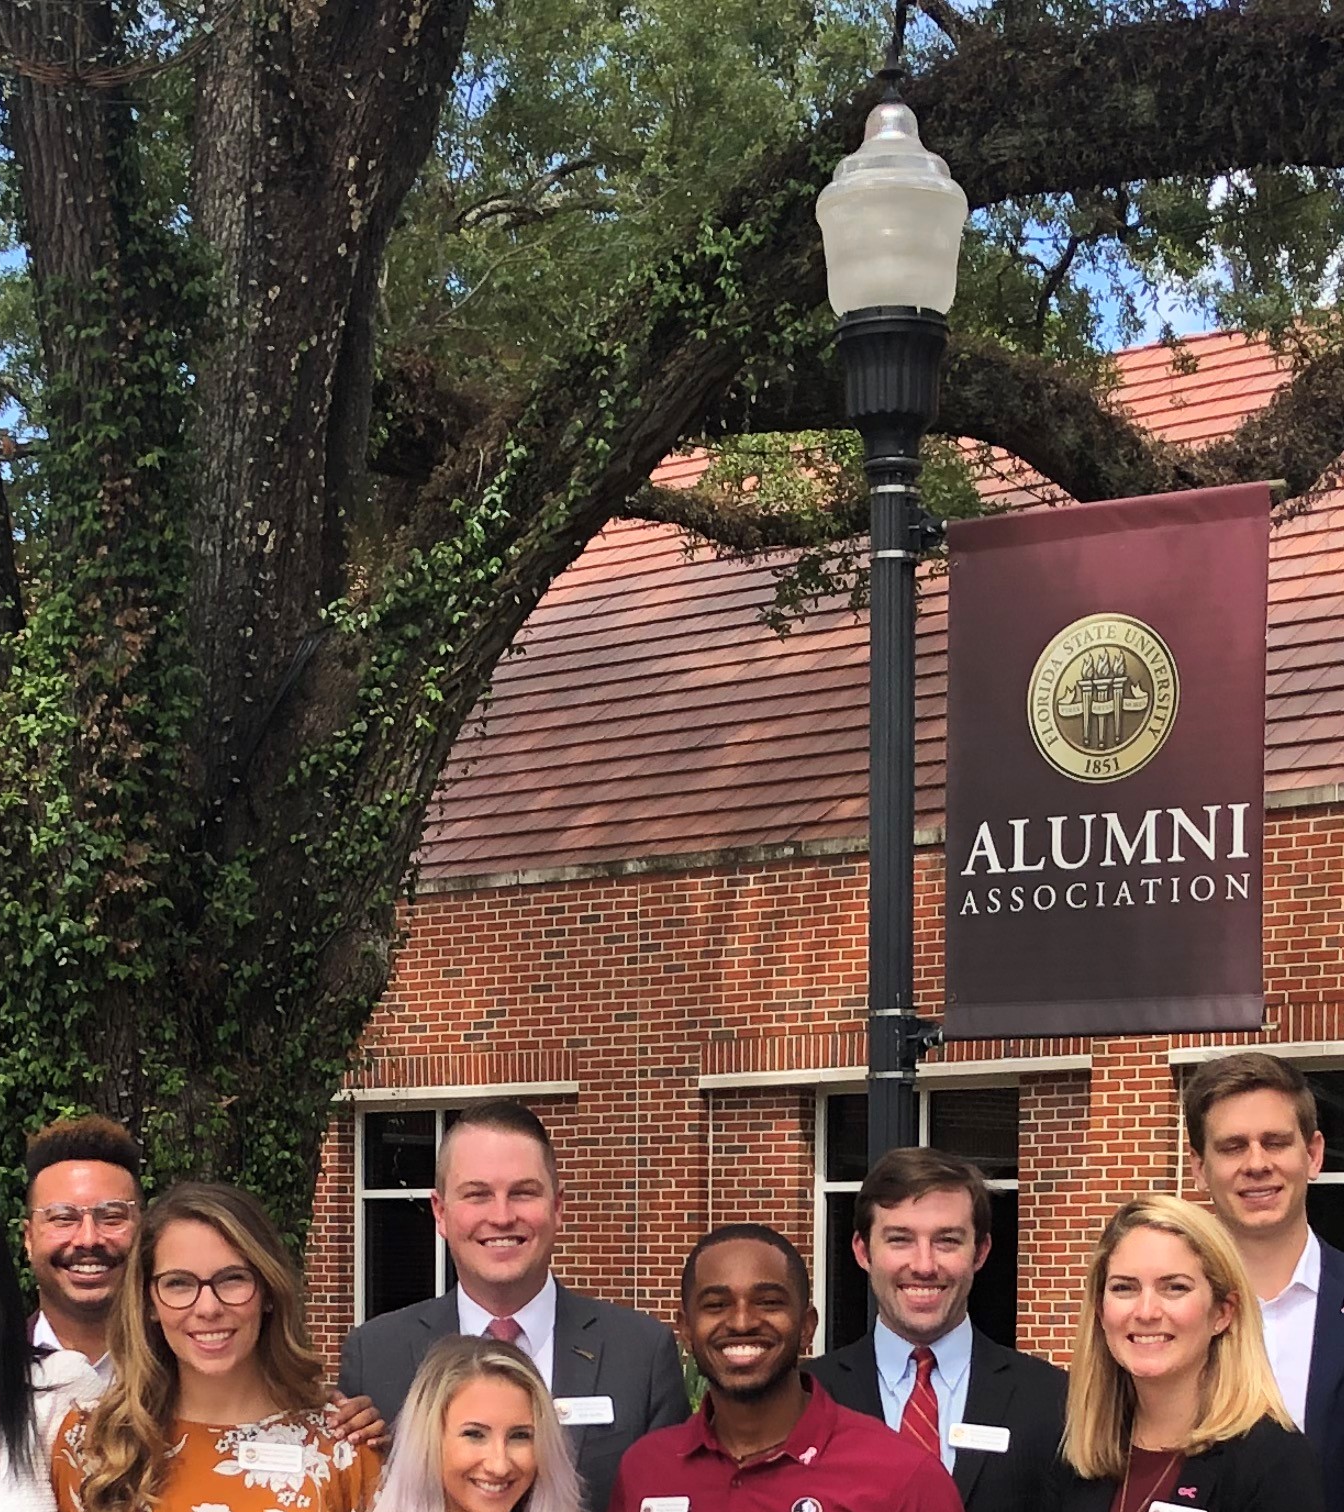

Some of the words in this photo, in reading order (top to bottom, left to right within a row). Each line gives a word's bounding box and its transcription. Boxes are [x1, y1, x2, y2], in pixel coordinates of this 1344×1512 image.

[1037, 659, 1063, 747] FLORIDA
[1062, 624, 1117, 656] STATE
[1125, 628, 1171, 740] UNIVERSITY
[1083, 756, 1121, 775] 1851
[960, 802, 1250, 875] ALUMNI
[959, 873, 1250, 915] ASSOCIATION
